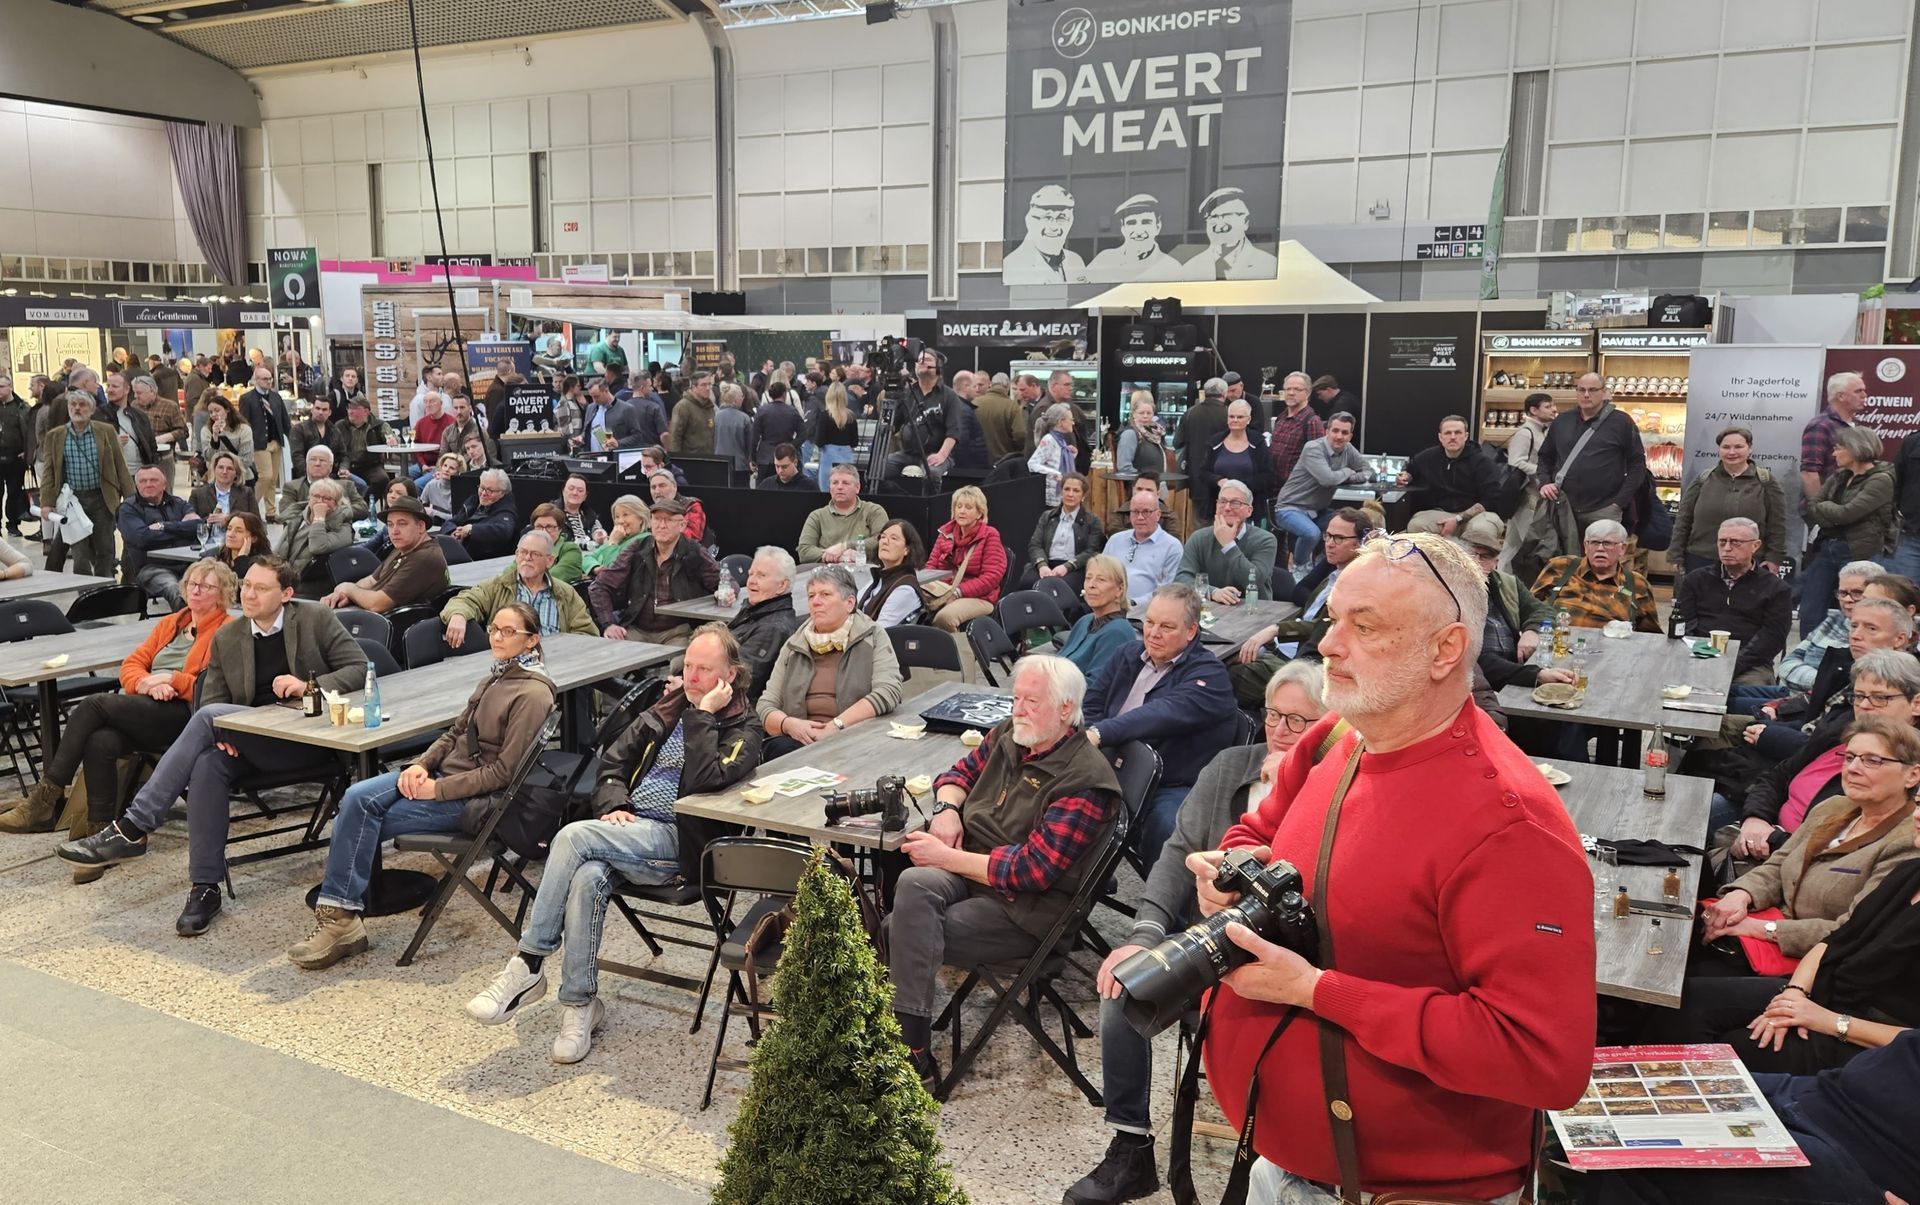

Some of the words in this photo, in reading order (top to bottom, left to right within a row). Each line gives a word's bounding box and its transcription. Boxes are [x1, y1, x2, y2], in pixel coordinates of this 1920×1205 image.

[1101, 6, 1242, 38] BONKHOFF'S
[1031, 47, 1262, 110] DAVERT
[1063, 103, 1223, 156] MEAT
[274, 250, 307, 261] NOWA
[54, 311, 85, 319] GUTEN
[157, 311, 198, 321] Gentlemen
[373, 300, 395, 338] HOME
[942, 324, 998, 336] DAVERT
[1039, 323, 1081, 336] MEAT
[1511, 338, 1582, 347] BONKHOFF'S
[1601, 337, 1647, 346] DAVERT
[1680, 337, 1707, 346] MEA
[375, 343, 396, 360] GO
[1136, 356, 1188, 365] BONKHOFF'S
[376, 365, 398, 383] OR
[1731, 377, 1744, 385] Ihr
[1747, 377, 1801, 387] Jagderfolg
[1721, 390, 1750, 398] Unser
[1753, 390, 1808, 399] Know-How
[377, 387, 400, 420] WILD
[509, 396, 550, 406] DAVERT
[515, 405, 544, 414] MEAT
[1705, 412, 1728, 421] 24/7
[1730, 413, 1793, 421] Wildannahme
[1695, 450, 1720, 458] Zerwi
[1242, 1115, 1254, 1145] Nikon
